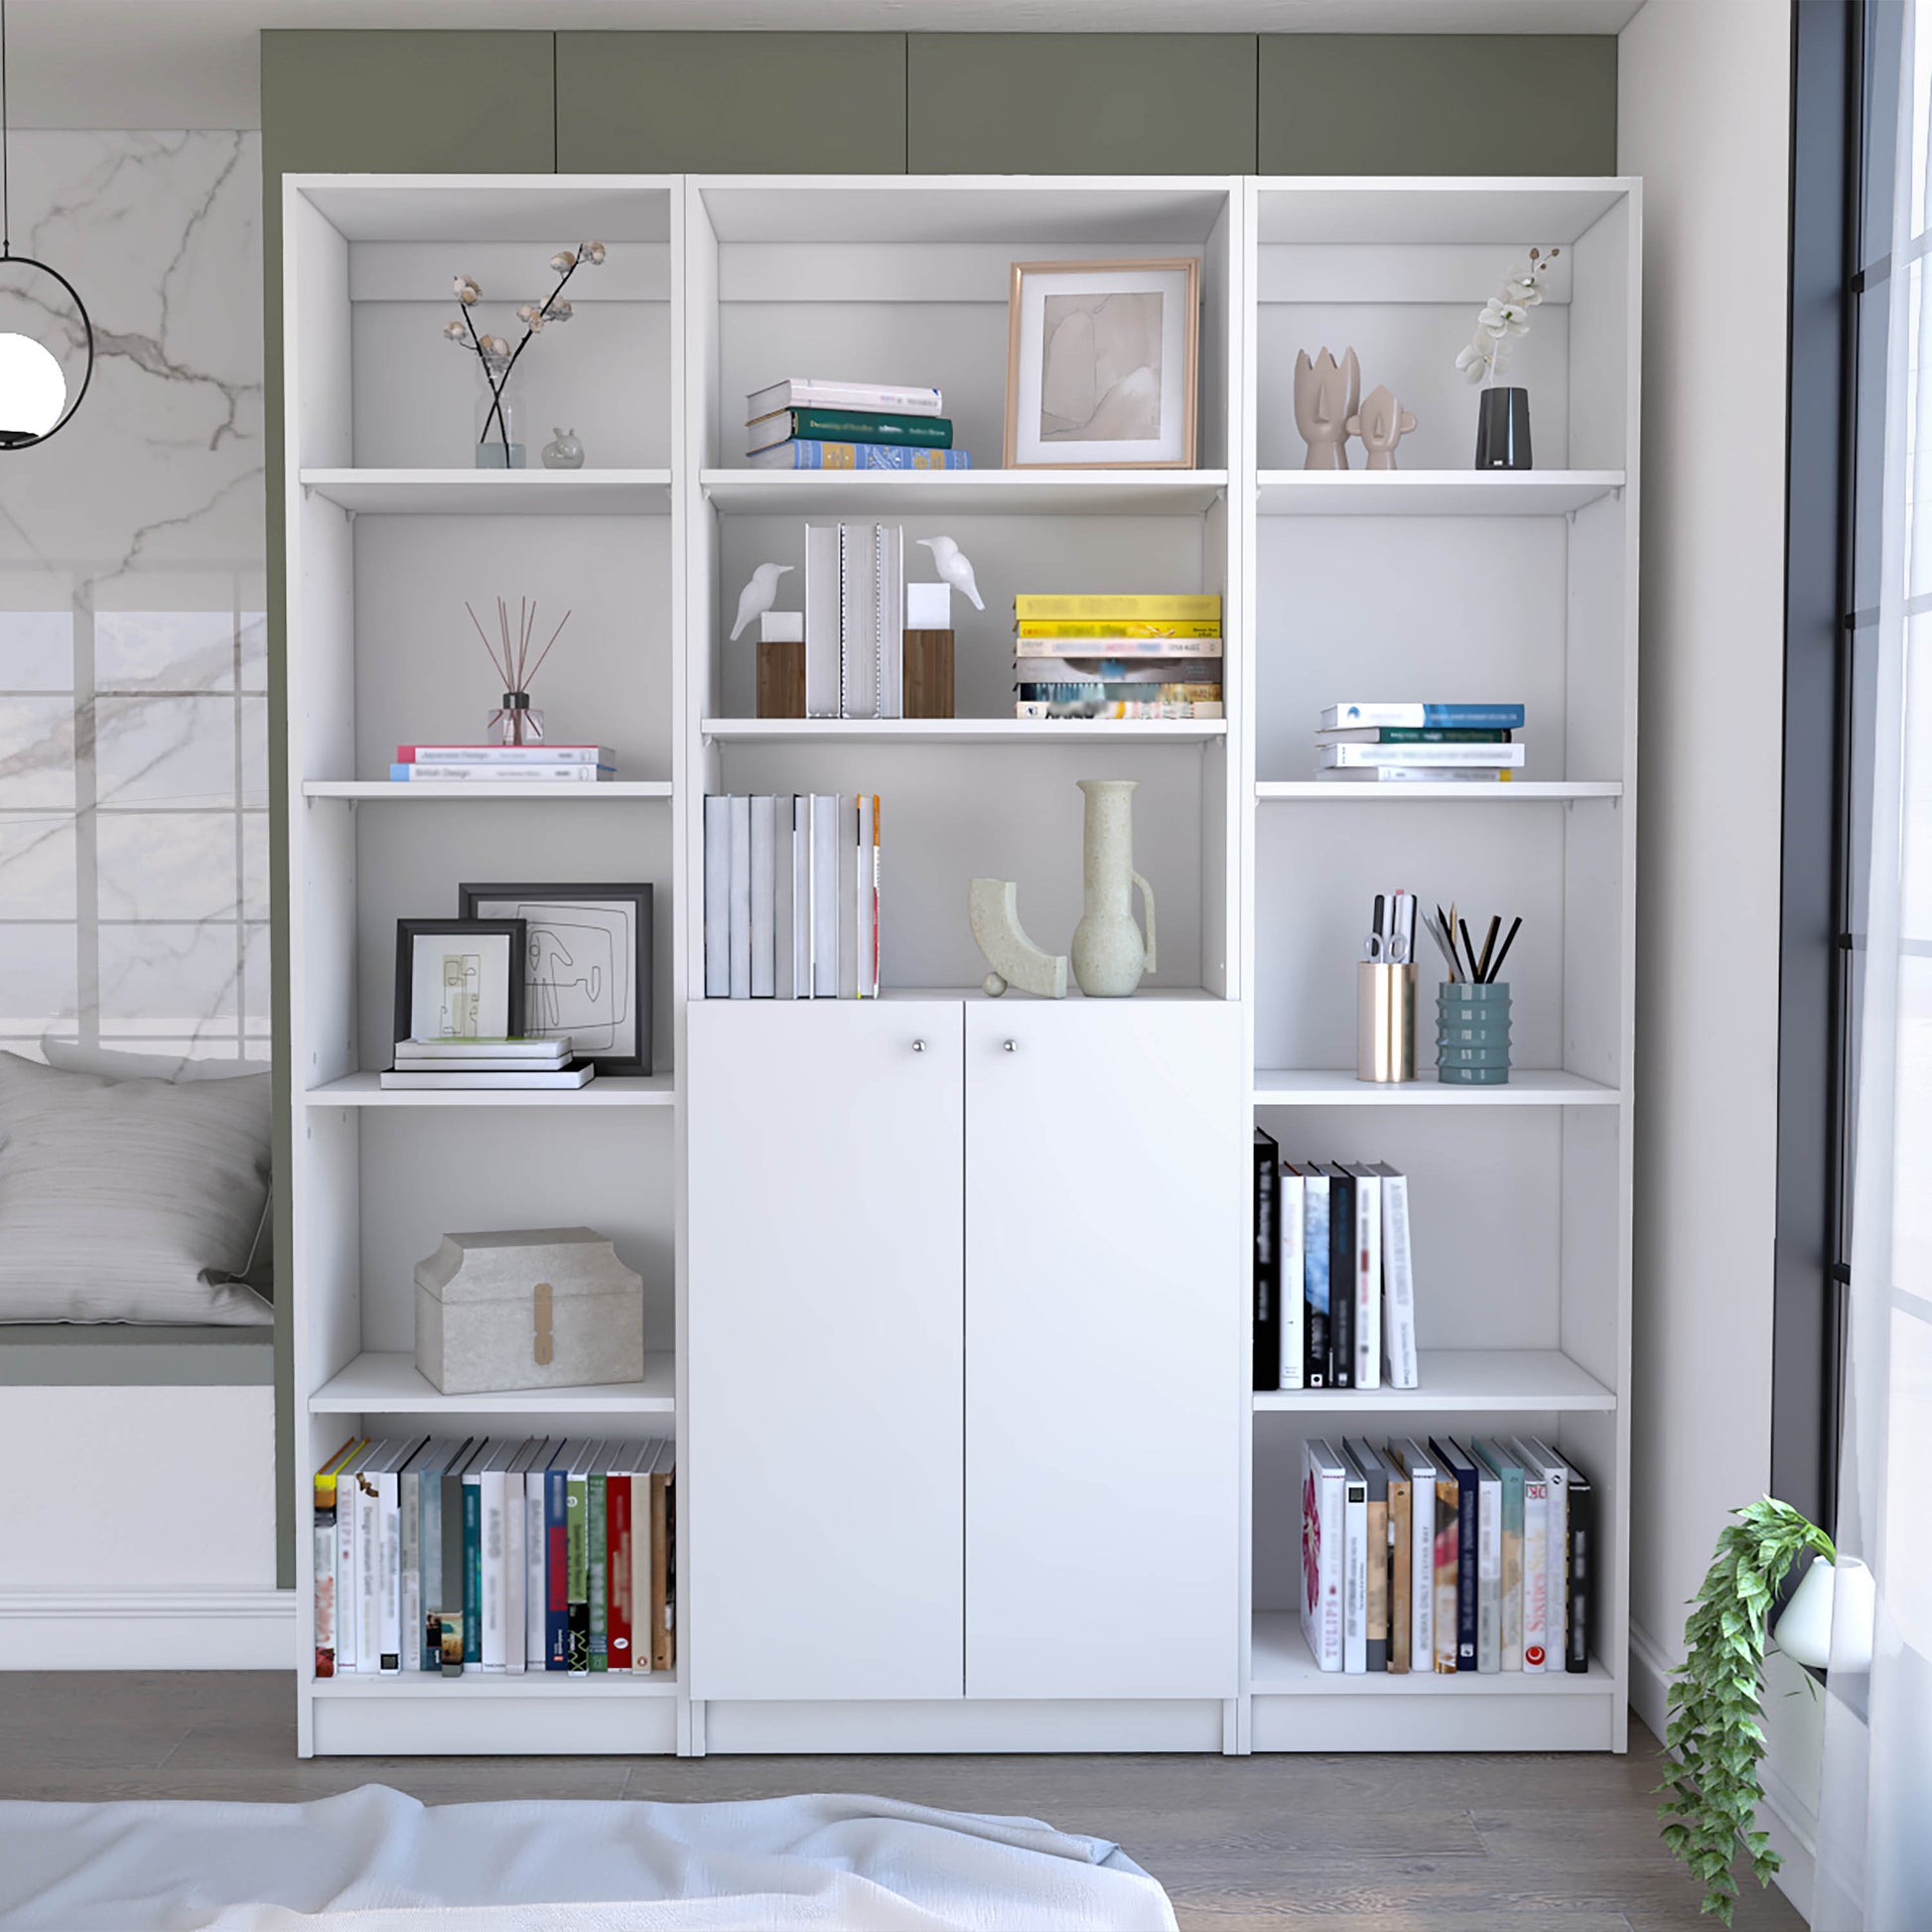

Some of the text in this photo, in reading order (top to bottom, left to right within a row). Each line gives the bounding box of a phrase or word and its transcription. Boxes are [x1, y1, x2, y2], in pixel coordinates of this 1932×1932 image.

[341, 1488, 352, 1545] TULIPS
[1324, 1598, 1339, 1659] TULIPS
[1525, 1572, 1546, 1633] Sixties
